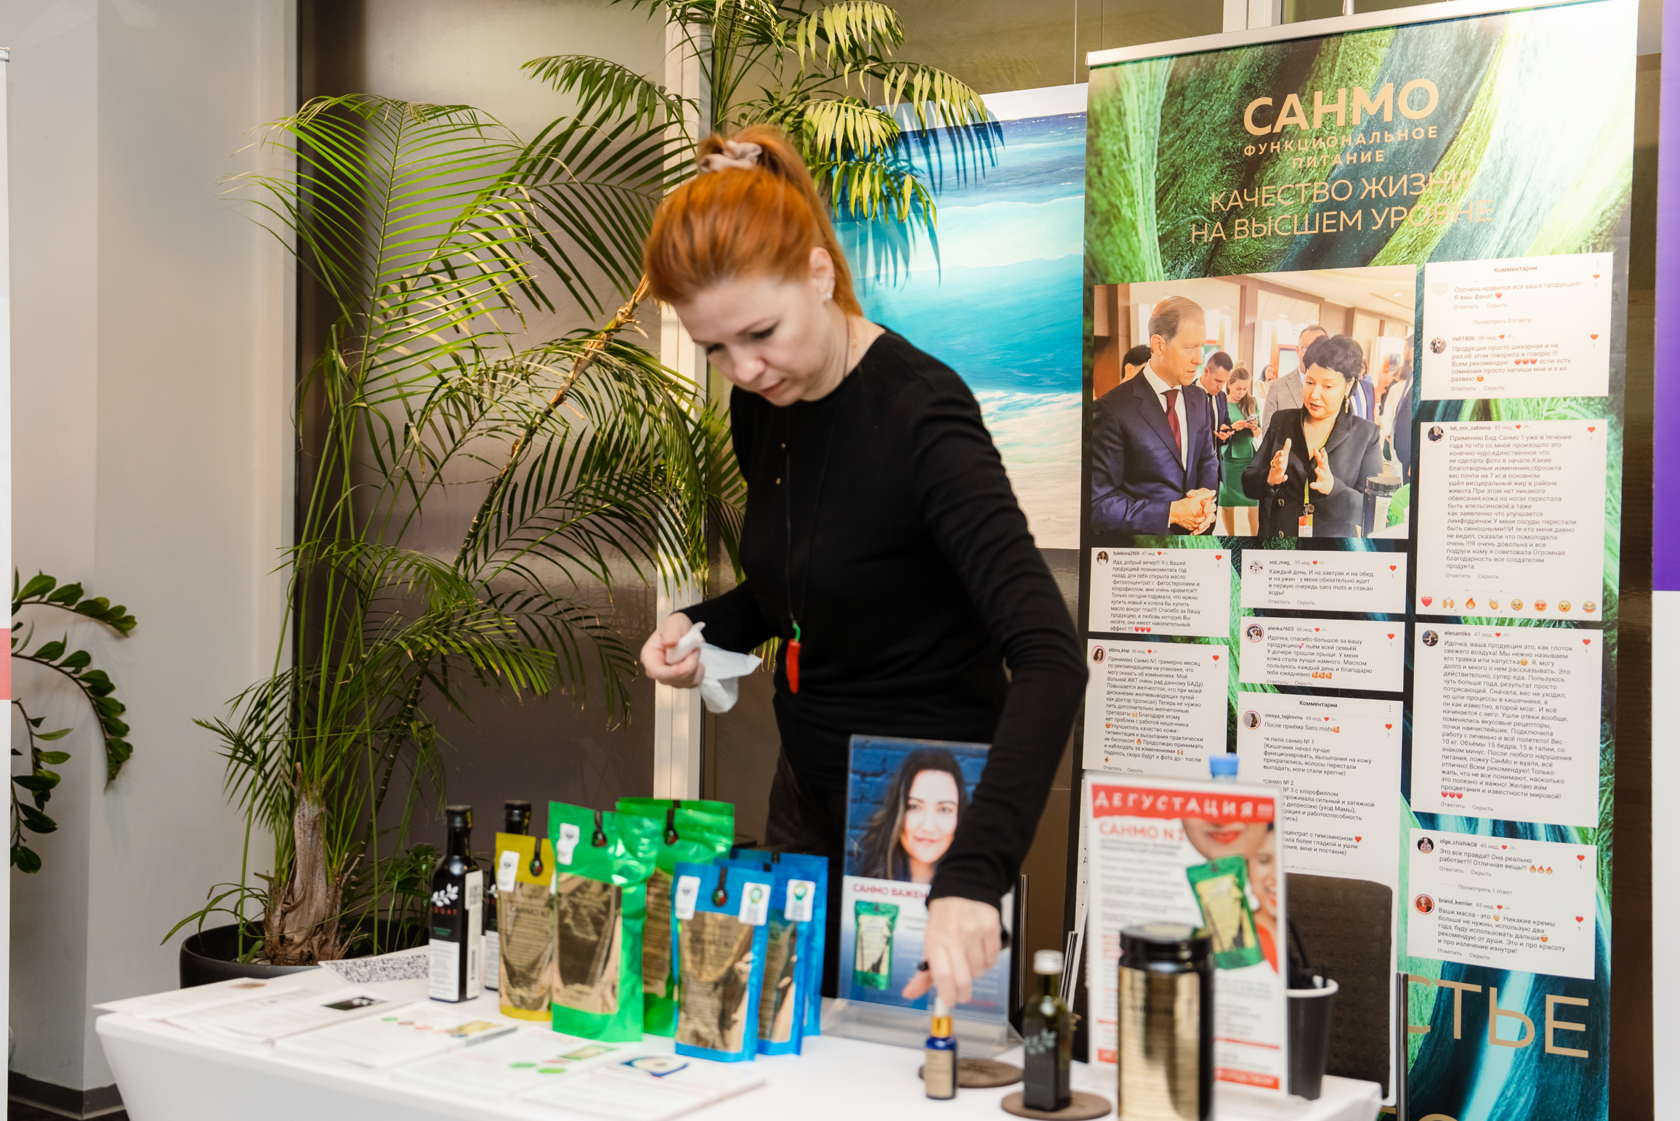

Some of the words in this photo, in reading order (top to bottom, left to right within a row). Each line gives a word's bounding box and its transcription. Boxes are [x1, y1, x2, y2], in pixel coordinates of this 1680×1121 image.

[1244, 78, 1439, 136] САНМО
[1244, 126, 1438, 157] ФУНКЦИОНАЛЬНОЕ
[1292, 150, 1385, 170] ПИТАНИЕ
[1211, 179, 1352, 212] КАЧЕСТВО
[1360, 169, 1470, 198] ЖИЗНИ
[1192, 222, 1226, 244] НА
[1234, 210, 1362, 239] ВЫСШЕМ
[1371, 199, 1493, 230] УРОВНЕ
[1528, 675, 1566, 683] Пользуюсь
[1299, 701, 1338, 709] Комментарии
[1511, 728, 1554, 737] Подключила
[1264, 743, 1294, 751] (Кишечник
[1532, 768, 1555, 776] Только
[1441, 785, 1481, 793] процветания
[1488, 789, 1529, 797] известности
[1094, 791, 1254, 818] ДЕГУСТАЦИЯ
[1099, 822, 1158, 839] САНМО
[1473, 860, 1503, 868] Отличная
[853, 884, 889, 894] САНМО
[1438, 915, 1462, 923] больше
[1495, 924, 1531, 933] использую
[1454, 925, 1468, 933] буду
[1469, 928, 1514, 938] использовать
[1515, 933, 1544, 943] дальше
[1456, 941, 1489, 950] излечение
